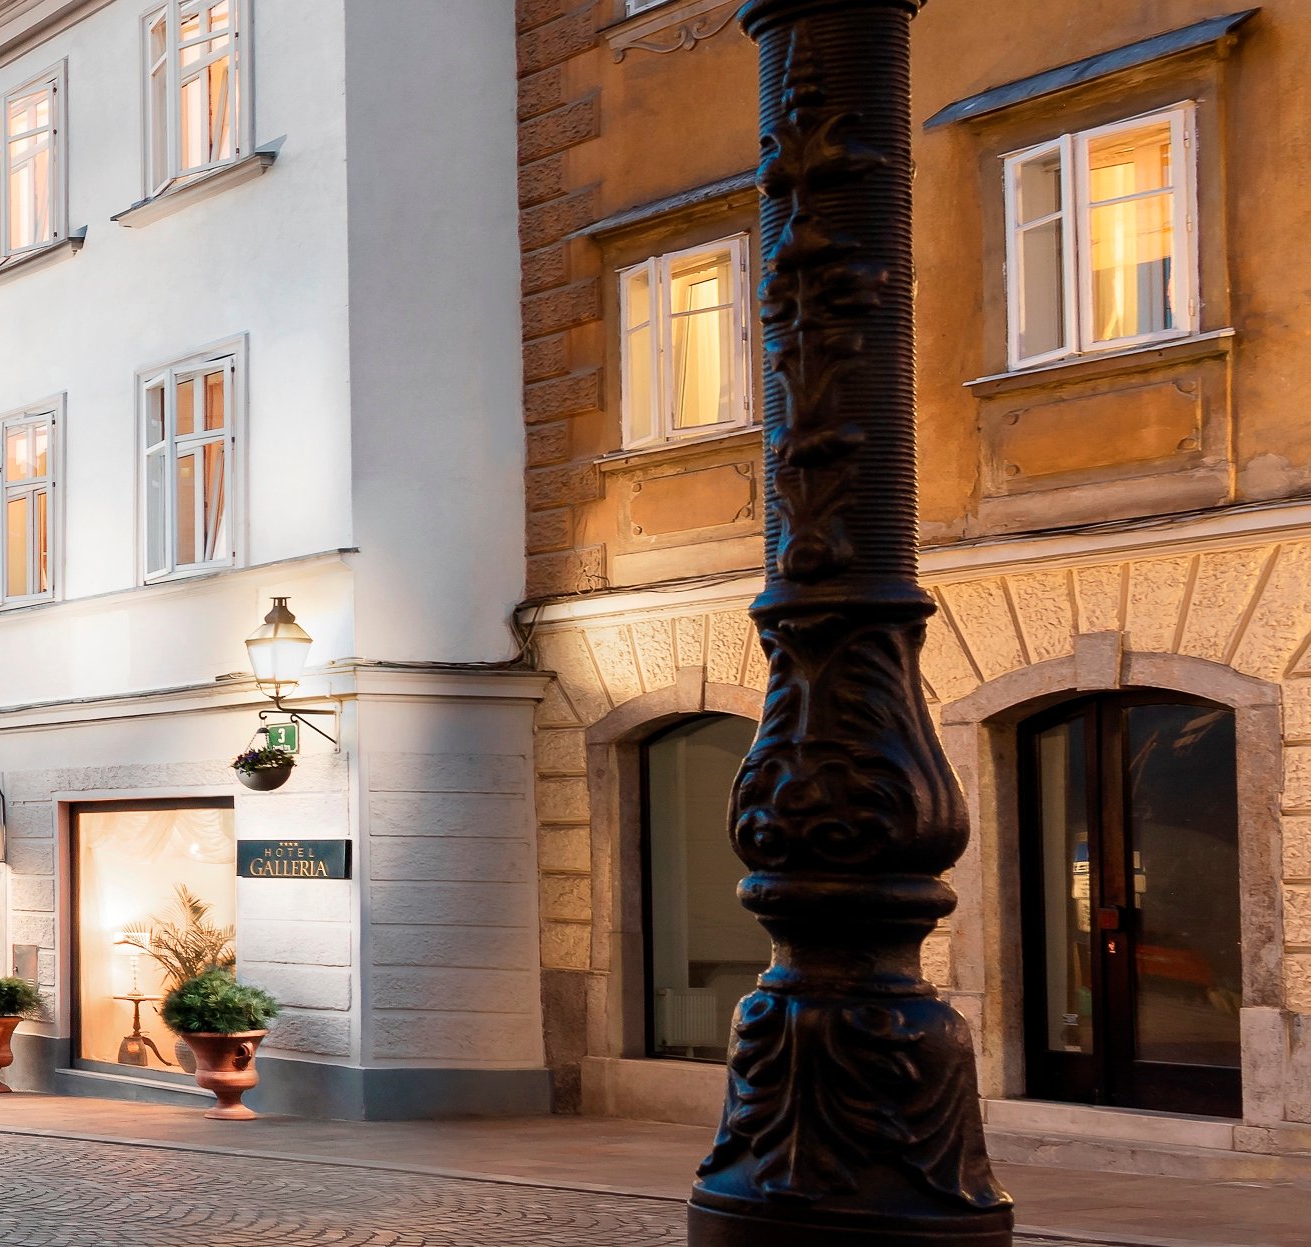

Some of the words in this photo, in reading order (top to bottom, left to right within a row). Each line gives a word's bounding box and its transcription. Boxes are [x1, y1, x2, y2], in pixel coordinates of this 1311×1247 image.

[277, 728, 286, 743] 3
[265, 848, 315, 858] HOTEL
[249, 857, 328, 877] GALLERIA
